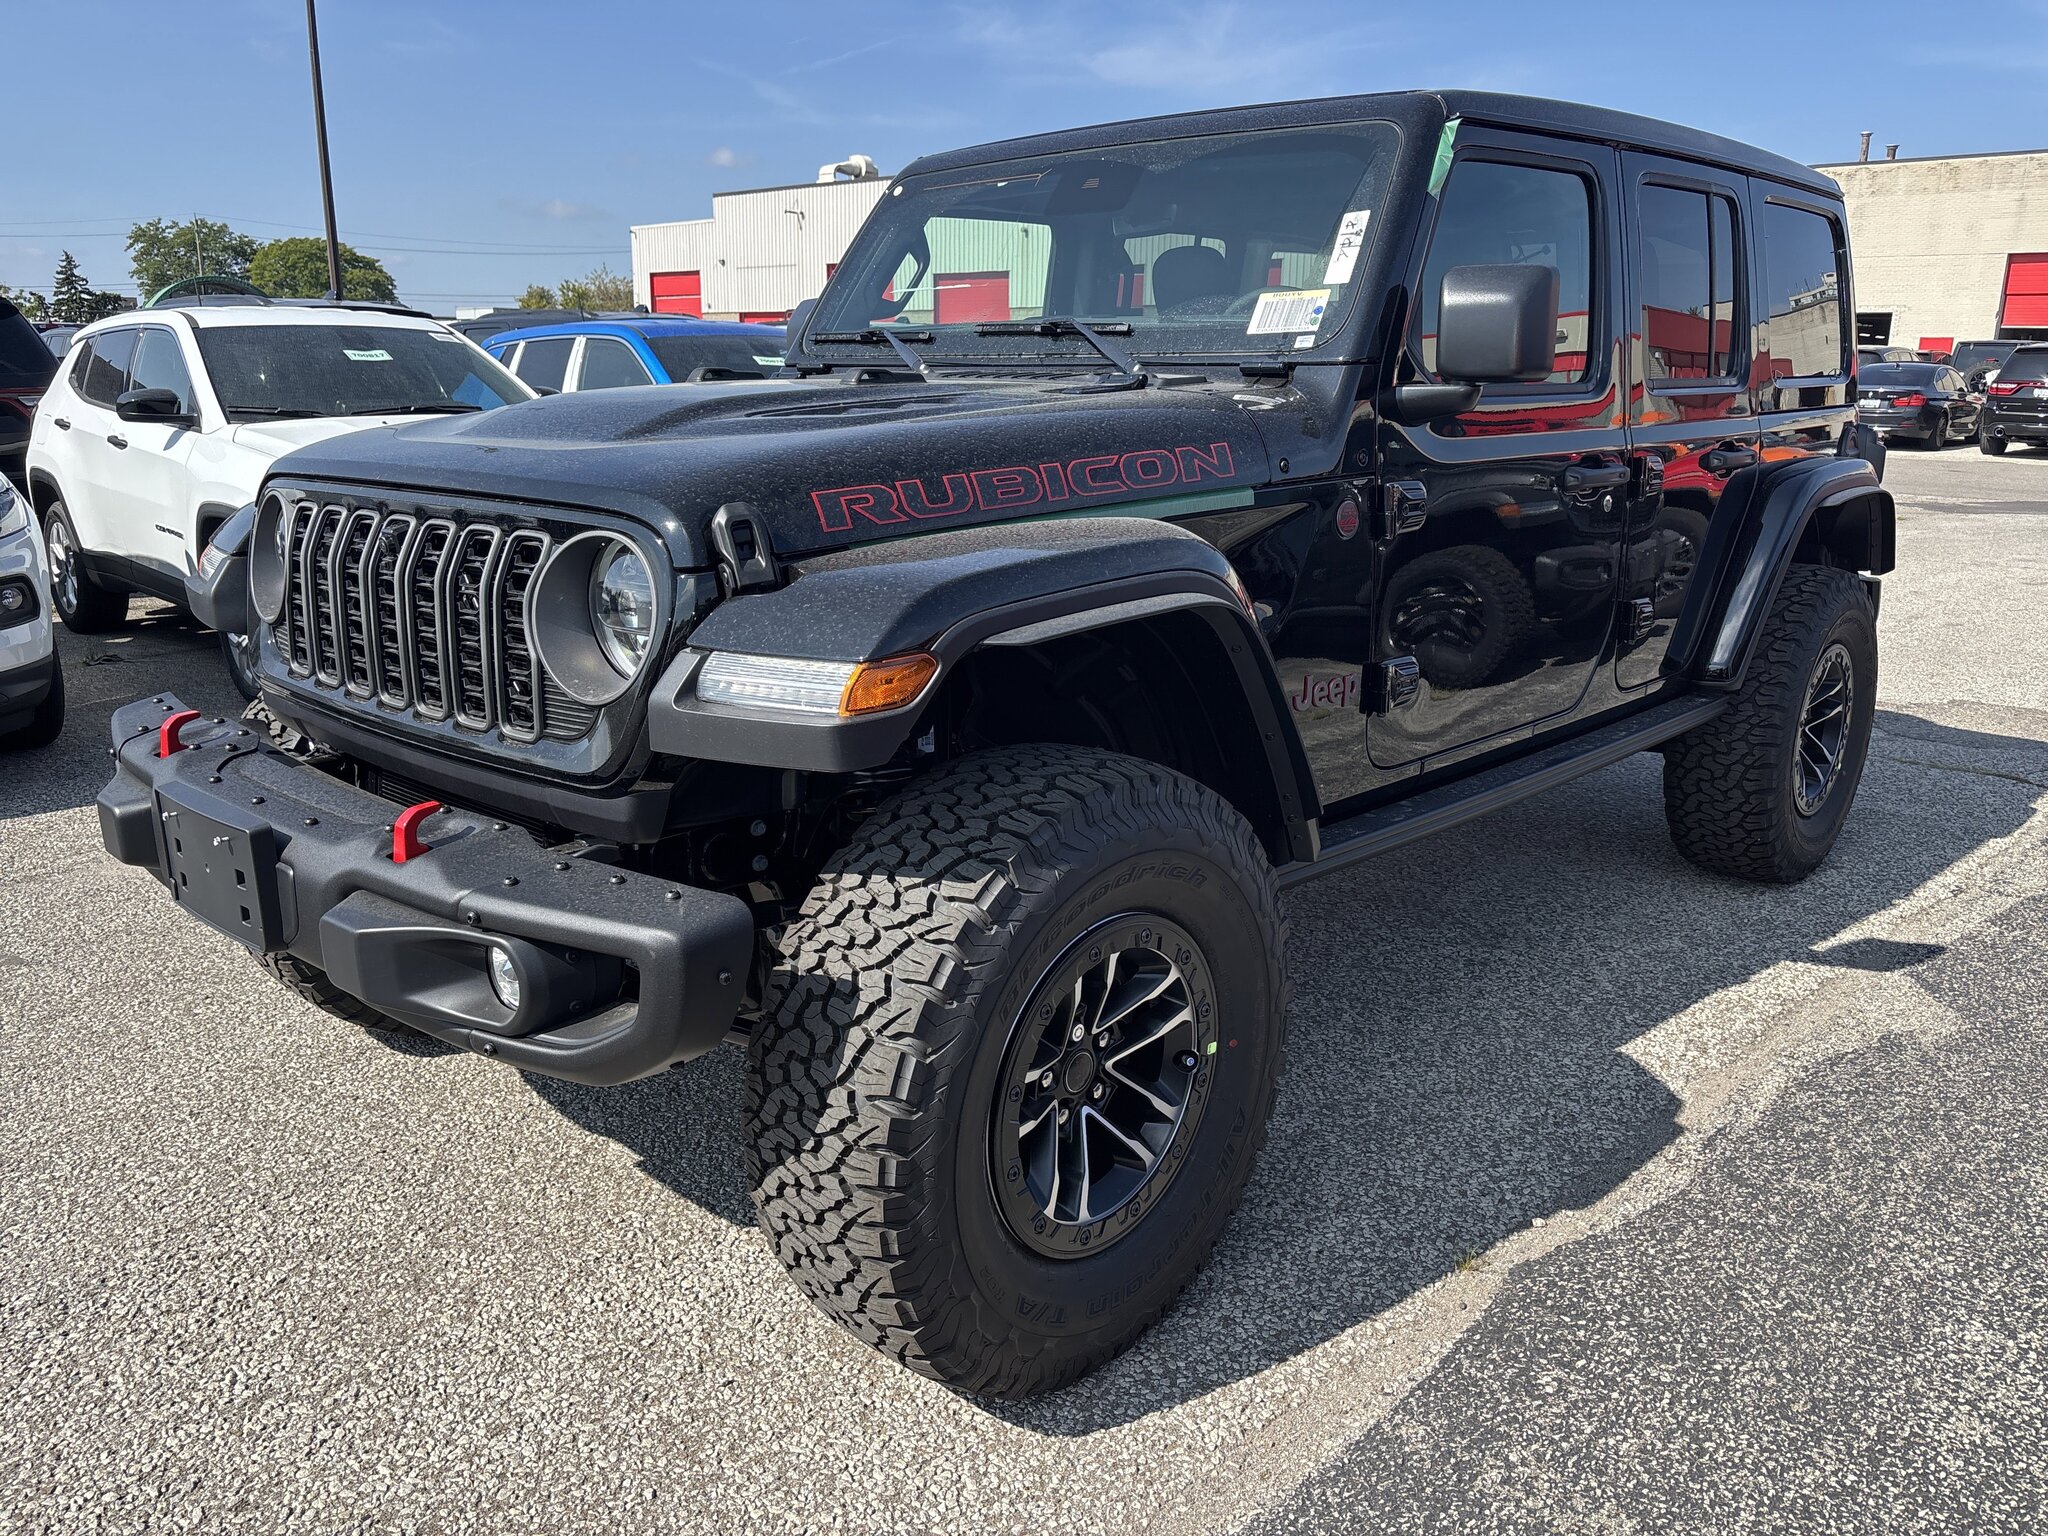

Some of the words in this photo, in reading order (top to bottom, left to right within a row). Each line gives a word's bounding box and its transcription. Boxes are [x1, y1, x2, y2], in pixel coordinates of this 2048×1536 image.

[810, 442, 1236, 533] RUBICON
[1291, 672, 1358, 711] Jeep
[999, 858, 1208, 1024] BFGoodrich
[1015, 1294, 1068, 1327] T/A
